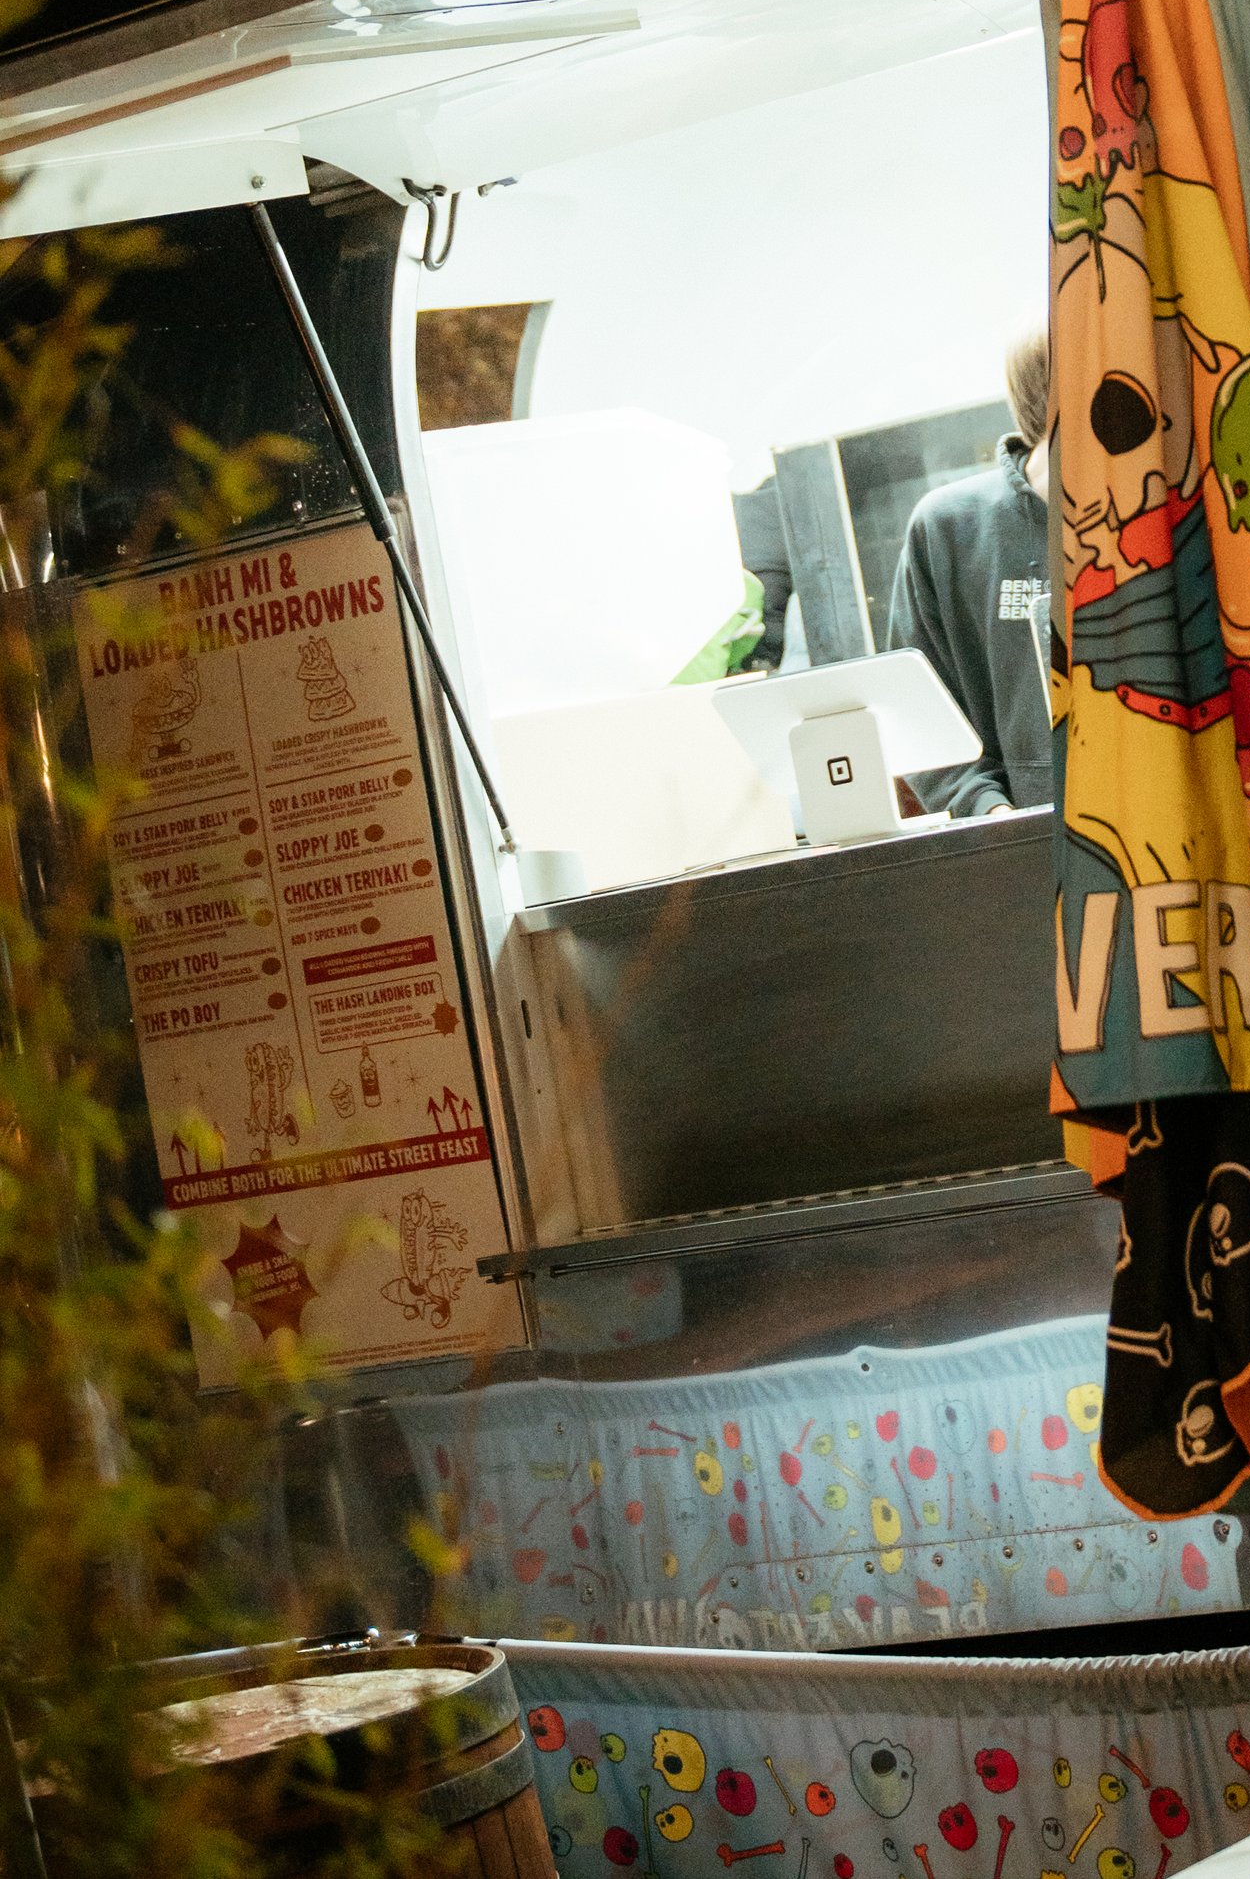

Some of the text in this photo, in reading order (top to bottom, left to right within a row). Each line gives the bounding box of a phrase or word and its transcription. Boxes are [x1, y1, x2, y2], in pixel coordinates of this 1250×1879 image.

[158, 550, 297, 617] BANH MI &
[1001, 579, 1042, 593] BENE
[194, 575, 385, 653] HASHBROWNS
[998, 606, 1031, 620] BEN
[268, 797, 290, 814] SOY
[290, 795, 299, 809] &
[300, 789, 326, 807] STAR
[327, 782, 357, 802] PORK
[358, 775, 390, 795] BELLY
[112, 831, 131, 848] SOY
[143, 823, 168, 841] STAR
[169, 817, 196, 836] PORK
[198, 810, 229, 830] BELLY
[275, 834, 330, 863] SLOPPY
[331, 827, 360, 851] JOE
[119, 868, 171, 895] SPPY
[173, 861, 200, 885] JOE
[282, 875, 343, 905] CHICKEN
[344, 862, 408, 893] TERIYAKI
[133, 958, 181, 984] CRISPY
[183, 950, 219, 975] TOFU
[314, 998, 334, 1015] THE
[335, 992, 364, 1011] HASH
[366, 983, 411, 1005] LANDING
[413, 979, 436, 996] BOX
[141, 1011, 168, 1033] THE
[170, 1007, 190, 1028] PO
[192, 1001, 221, 1024] BOY
[171, 1133, 479, 1203] COMBINE BOTH FOR THE ULTIMATE STREET FEAST
